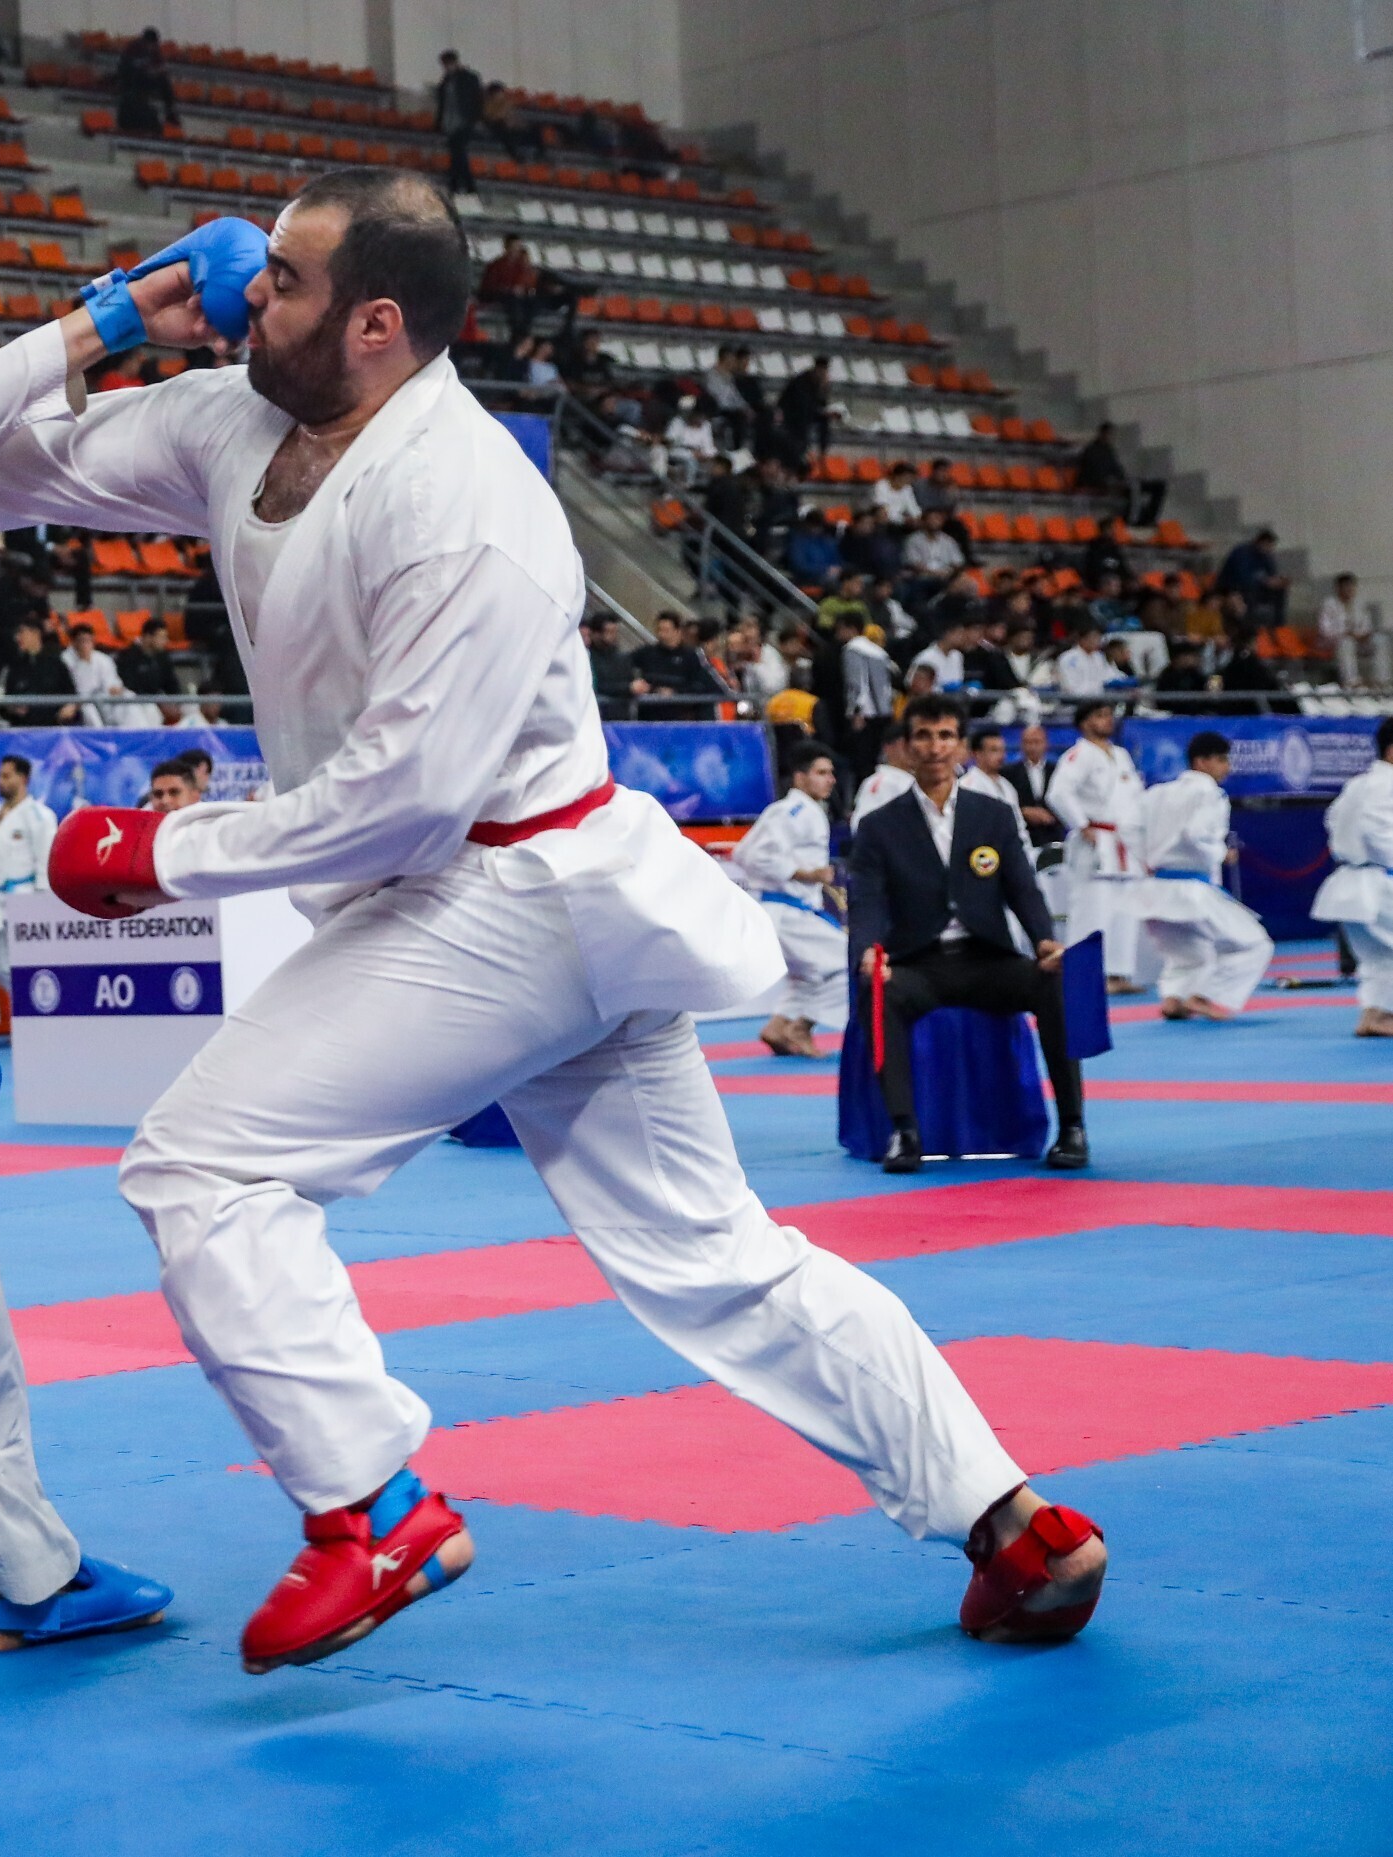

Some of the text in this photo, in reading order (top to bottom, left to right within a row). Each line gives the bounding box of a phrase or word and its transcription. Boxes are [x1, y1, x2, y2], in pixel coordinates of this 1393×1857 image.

[14, 916, 213, 942] IRAN KARATE FEDERATION
[94, 974, 136, 1009] AO
